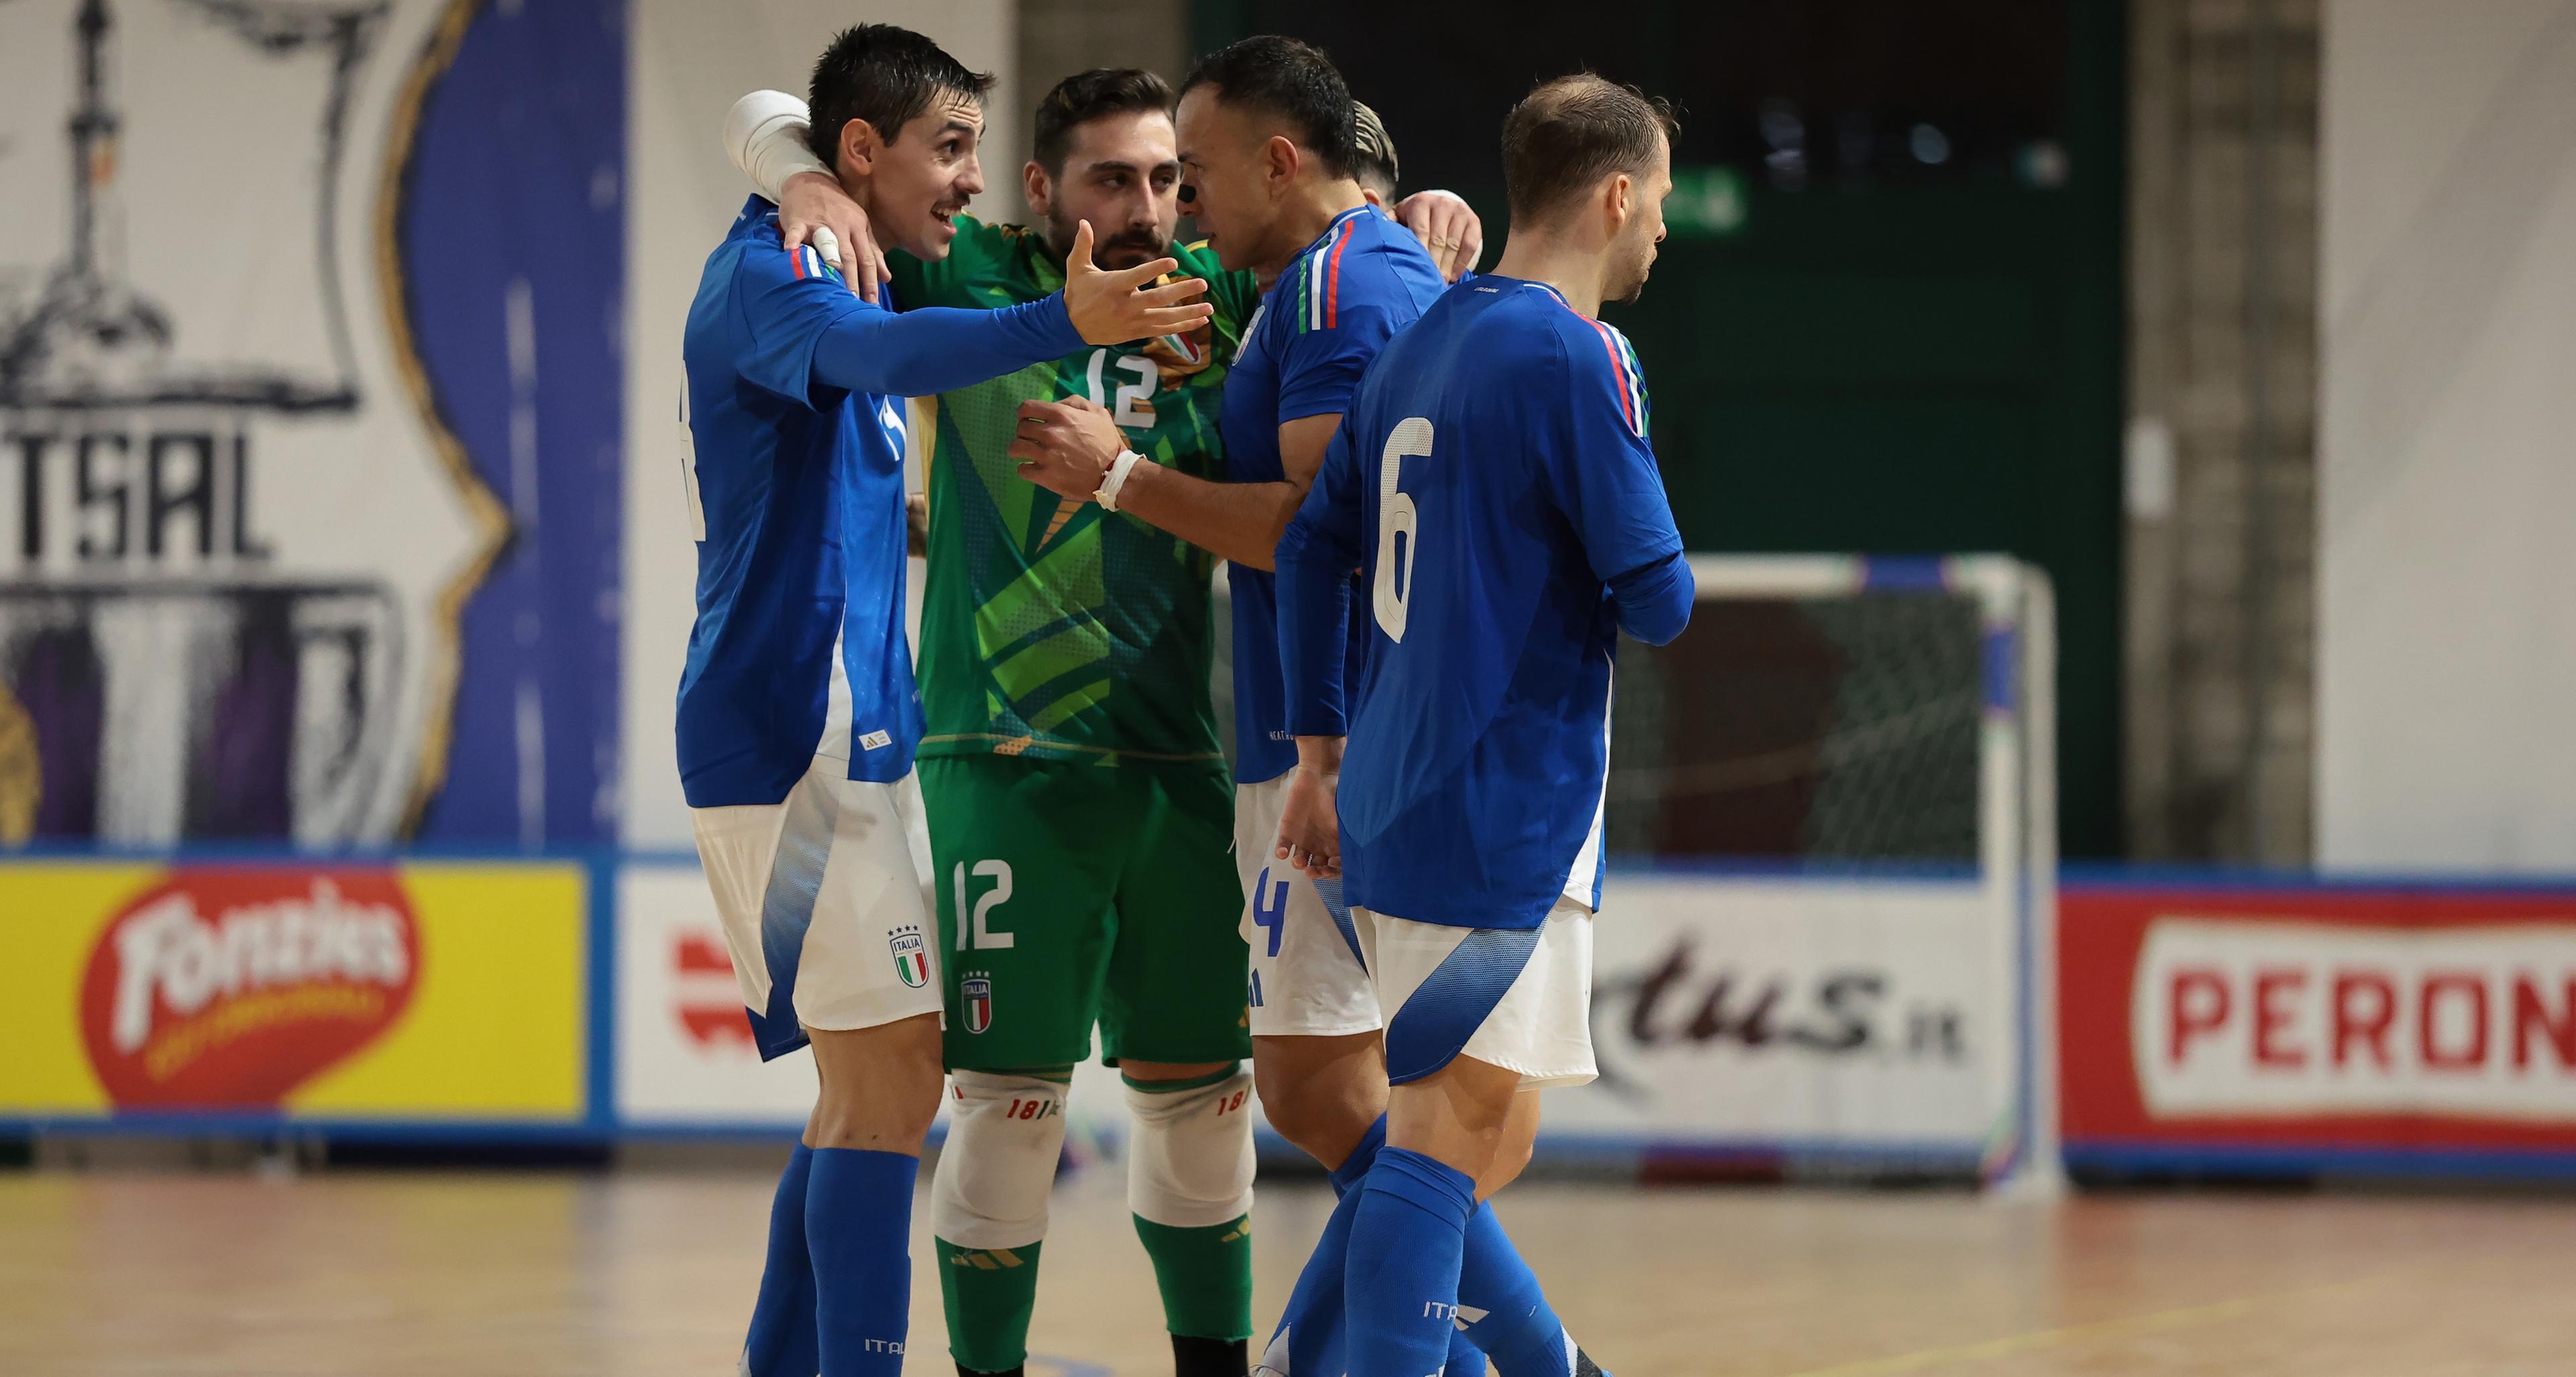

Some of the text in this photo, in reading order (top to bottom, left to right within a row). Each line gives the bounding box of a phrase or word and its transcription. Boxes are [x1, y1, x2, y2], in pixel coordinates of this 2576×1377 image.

[1087, 348, 1158, 428] 12
[1373, 417, 1434, 645] 6
[894, 938, 920, 952] ITALIA
[953, 859, 1014, 951] 12
[1253, 867, 1289, 957] 4
[965, 984, 988, 995] ITALIA
[2169, 969, 2576, 1069] PERON
[1007, 1099, 1051, 1120] 181
